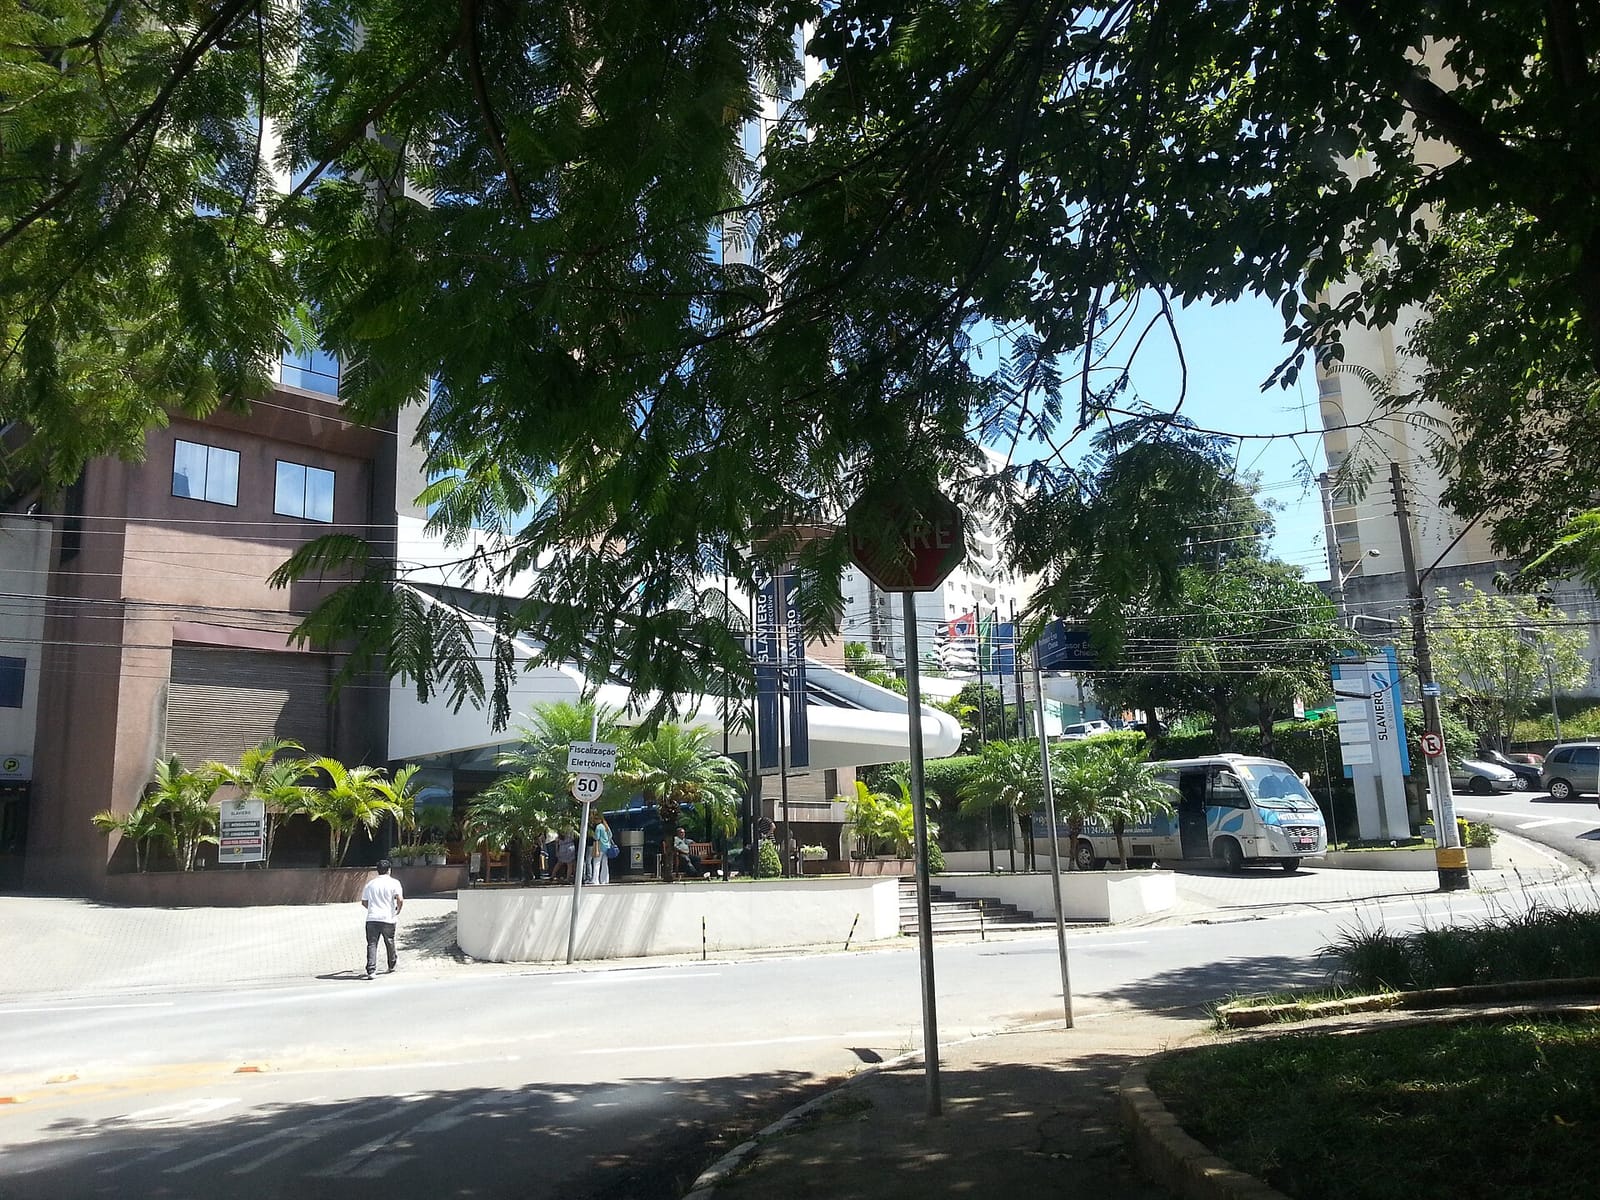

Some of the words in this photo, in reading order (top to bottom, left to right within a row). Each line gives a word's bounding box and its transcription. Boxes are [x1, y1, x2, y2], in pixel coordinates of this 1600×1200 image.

[856, 519, 952, 550] RE
[758, 594, 769, 663] SLAVIERO
[787, 609, 799, 677] SLAVIERO
[1373, 690, 1389, 741] SLAVIERO
[569, 746, 616, 757] Fiscalização
[571, 758, 611, 769] Eletrônica
[577, 778, 598, 793] 50
